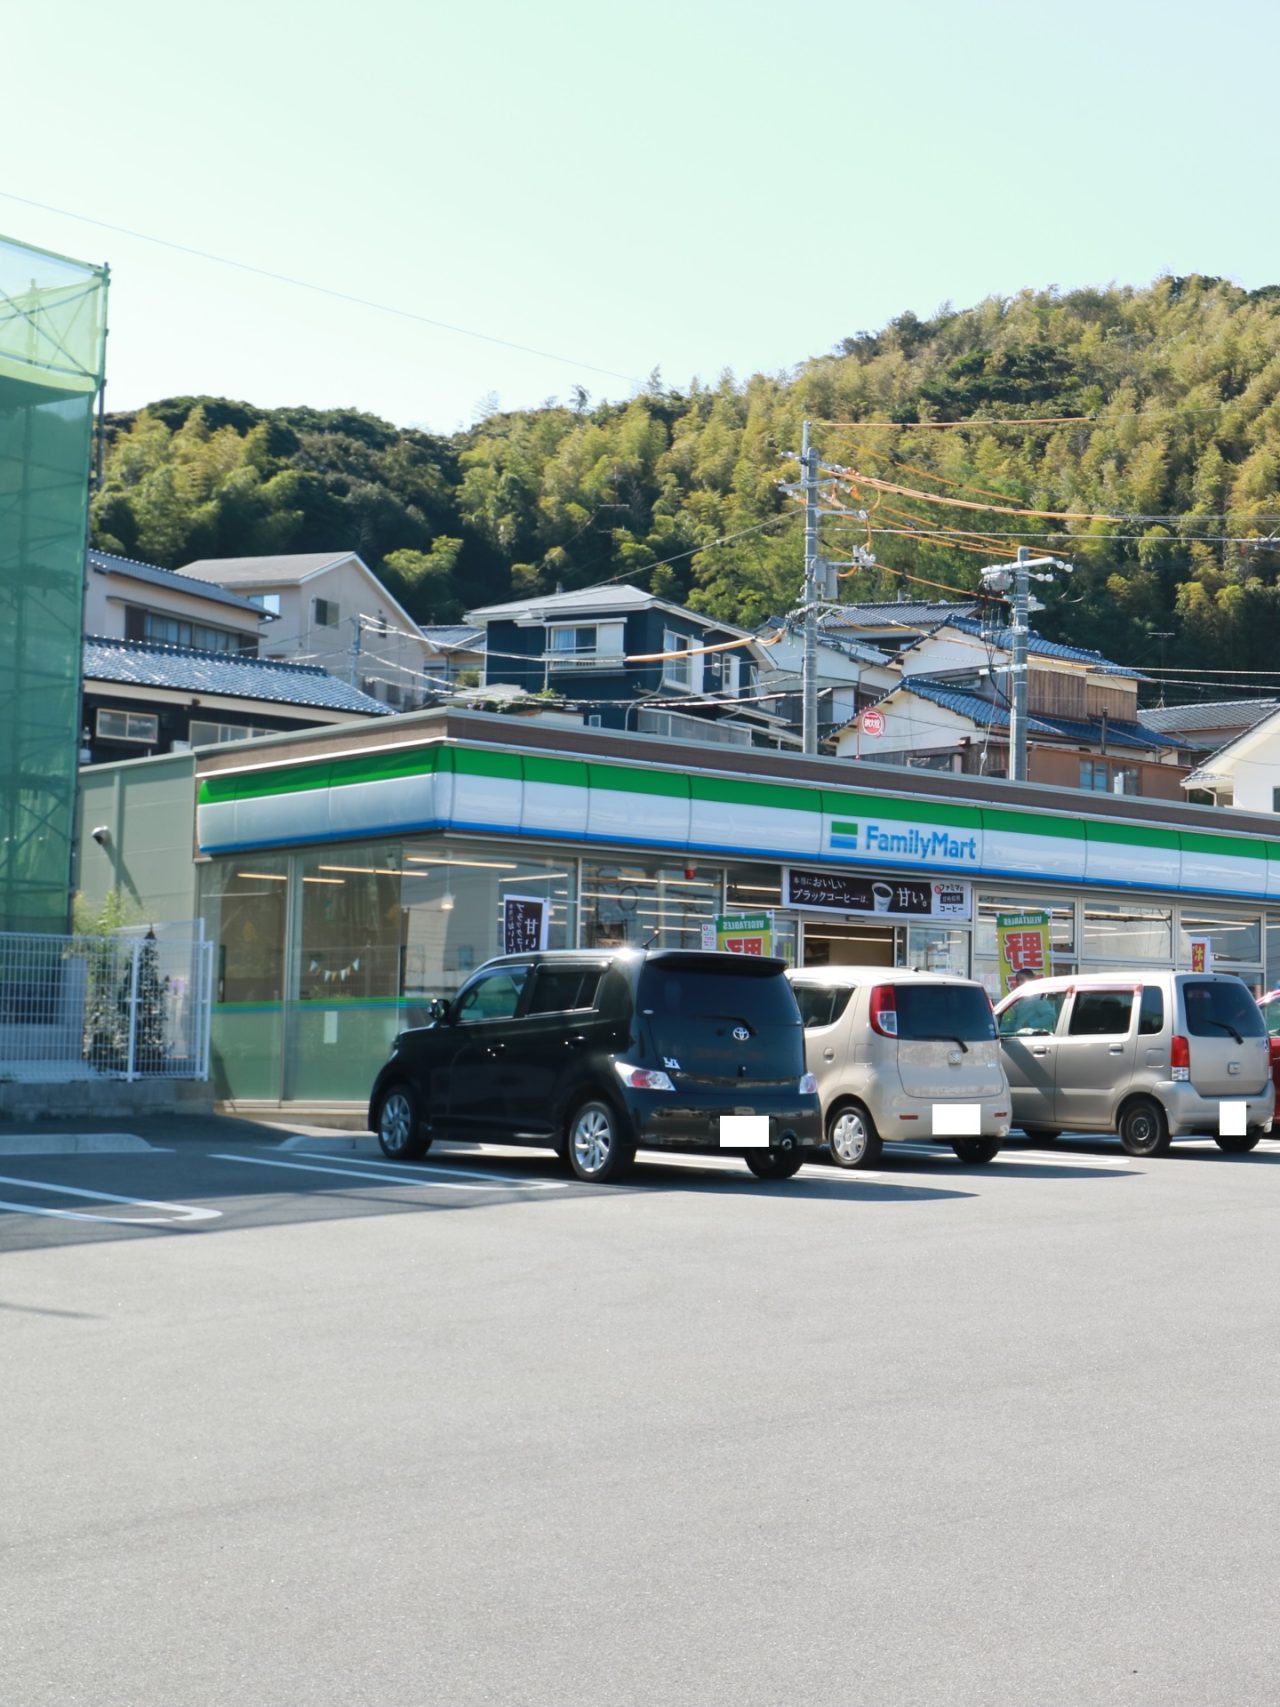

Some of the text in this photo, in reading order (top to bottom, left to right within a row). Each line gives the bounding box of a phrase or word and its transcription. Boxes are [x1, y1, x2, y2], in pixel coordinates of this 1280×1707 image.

[866, 825, 976, 859] FamilyMart
[940, 905, 964, 913] コーヒー
